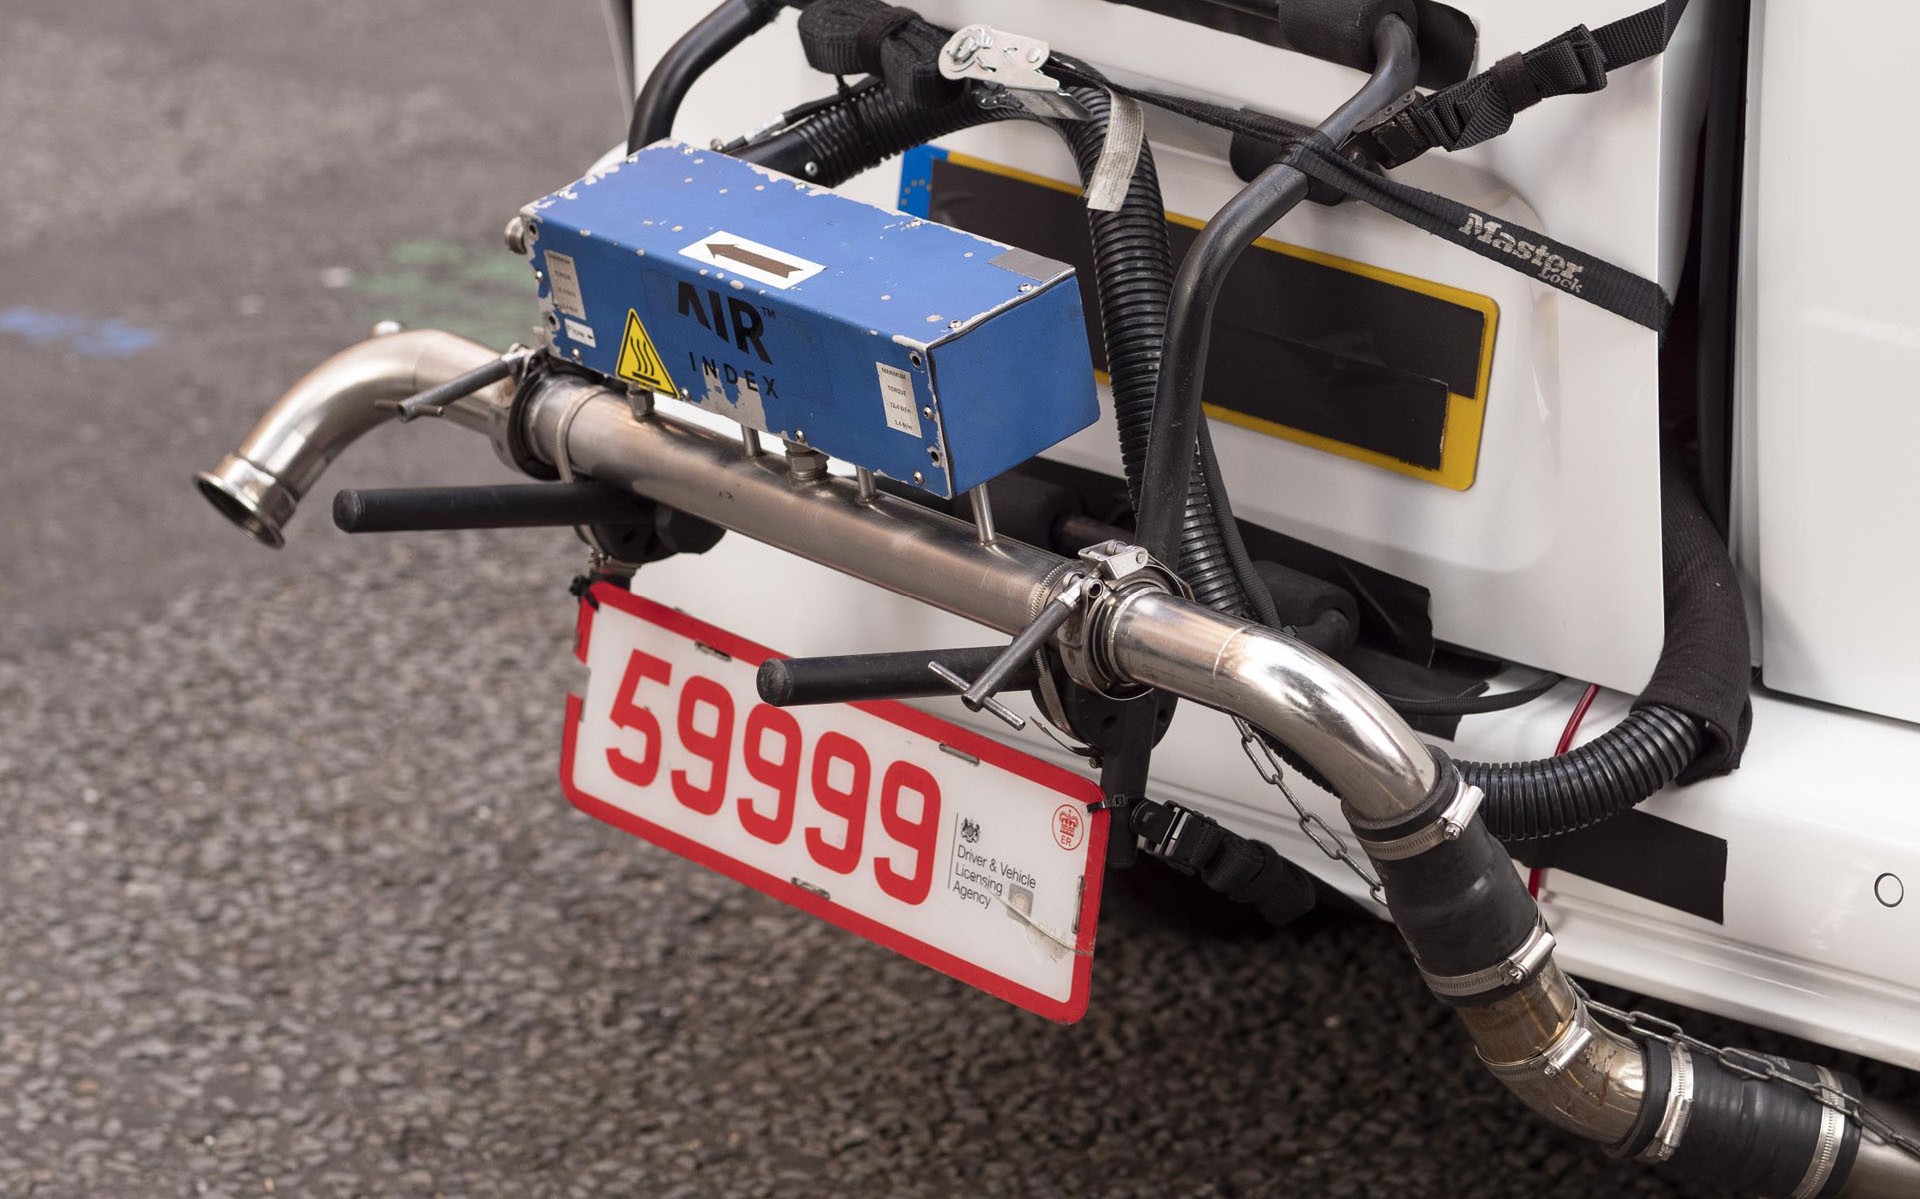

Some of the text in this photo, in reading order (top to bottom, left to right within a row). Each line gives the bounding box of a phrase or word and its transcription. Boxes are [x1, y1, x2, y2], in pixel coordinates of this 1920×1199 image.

[1459, 212, 1584, 279] Master
[1538, 266, 1583, 294] Lock
[689, 351, 779, 399] INDEX
[887, 385, 907, 397] TORQUE
[605, 648, 943, 906] 59999
[1060, 834, 1071, 847] ER
[955, 863, 1003, 897] Licensing
[957, 844, 1036, 889] Driver & Vehicle
[952, 880, 992, 909] Agency
